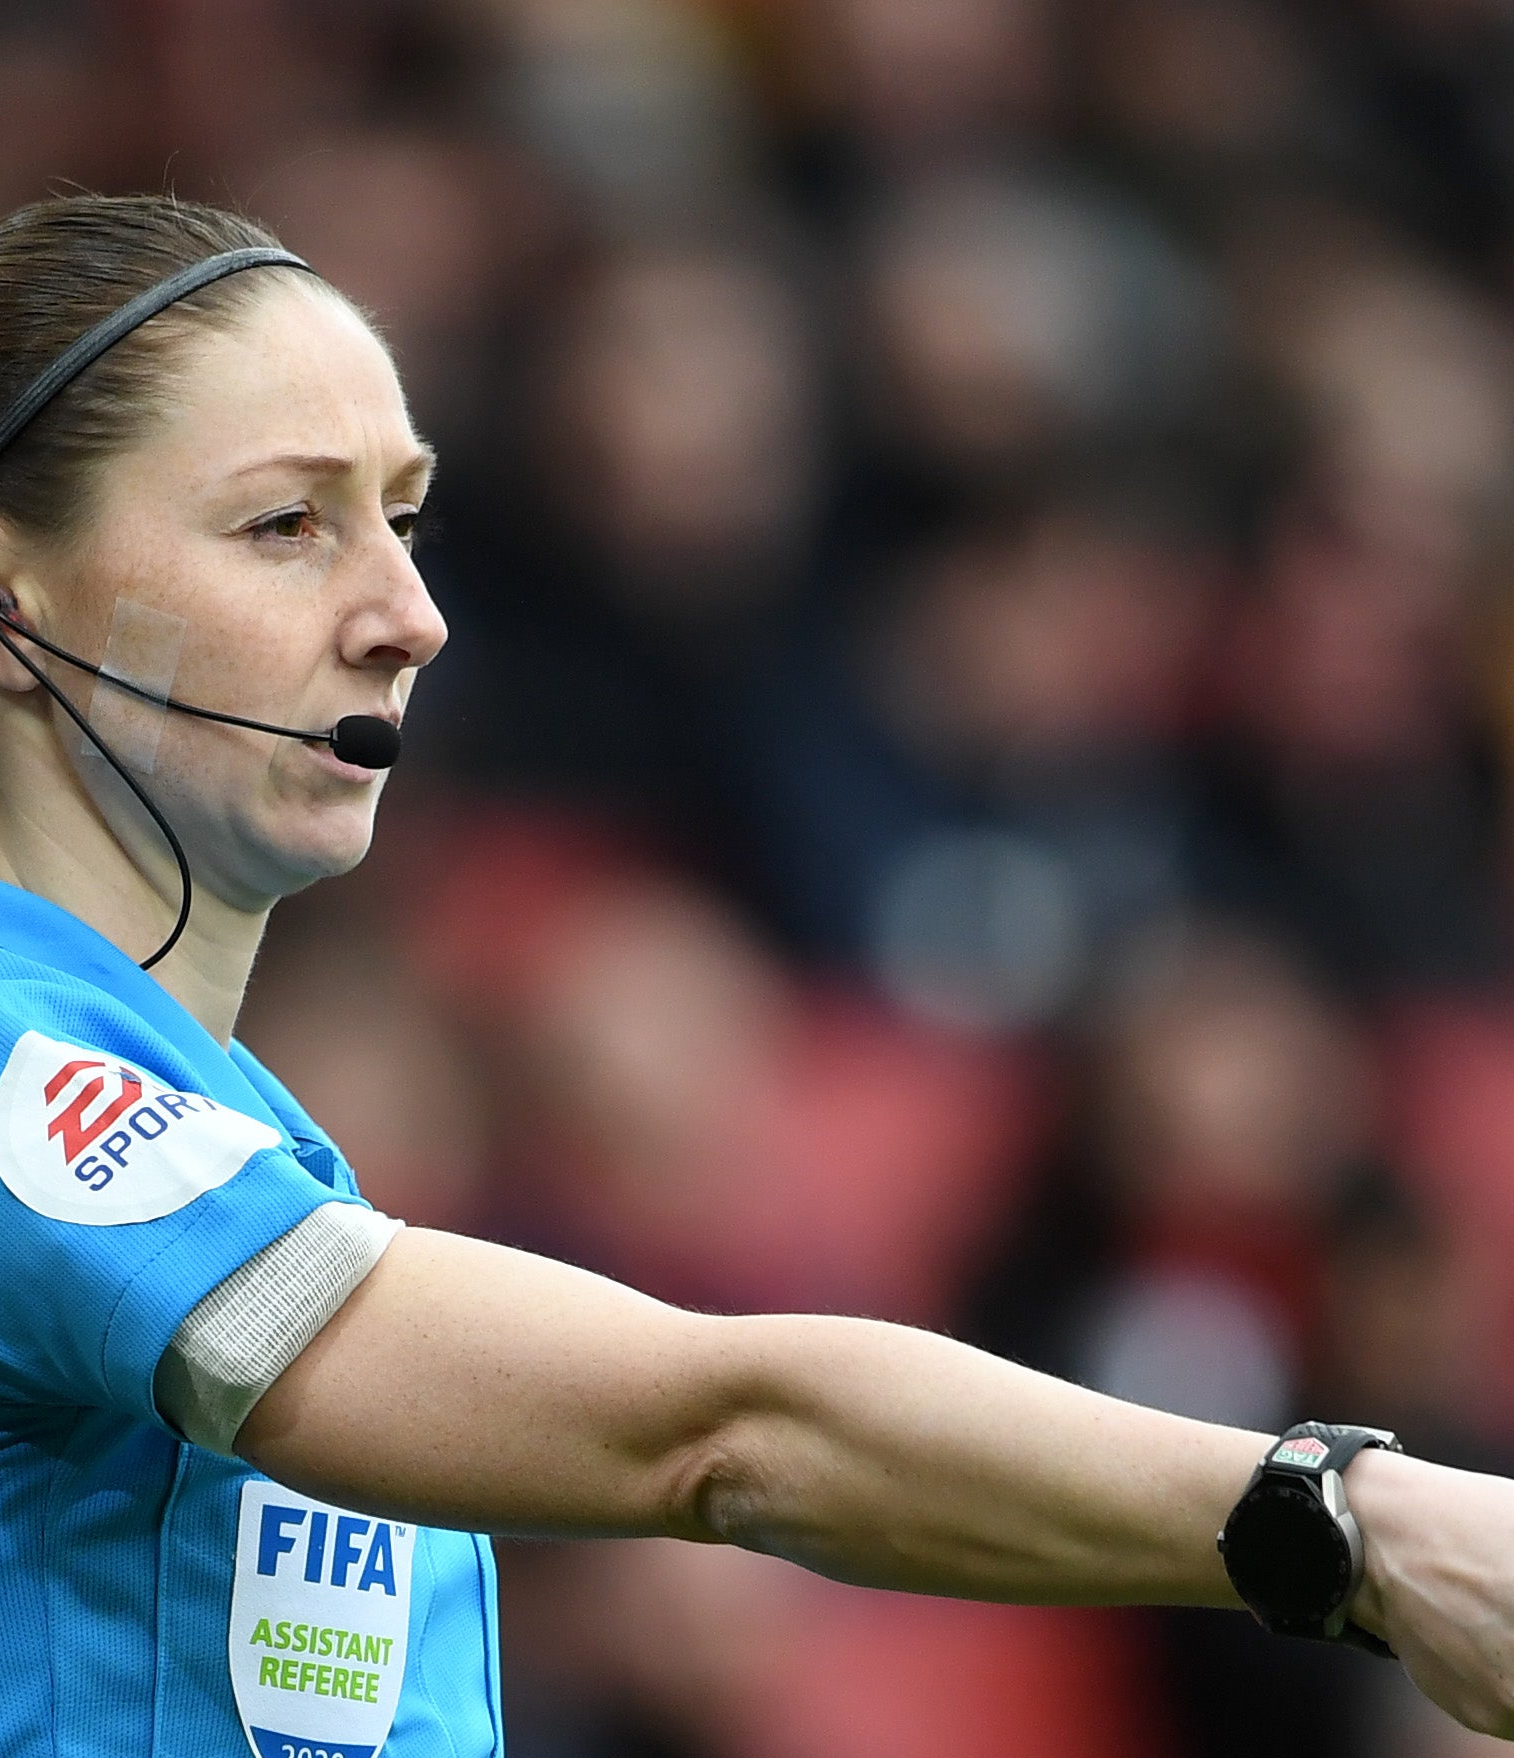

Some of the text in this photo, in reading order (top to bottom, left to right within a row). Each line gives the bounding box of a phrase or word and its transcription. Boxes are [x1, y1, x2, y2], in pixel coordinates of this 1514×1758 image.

[256, 1503, 397, 1597] FIFA
[249, 1618, 394, 1666] ASSISTANT
[258, 1656, 380, 1704] REFEREE
